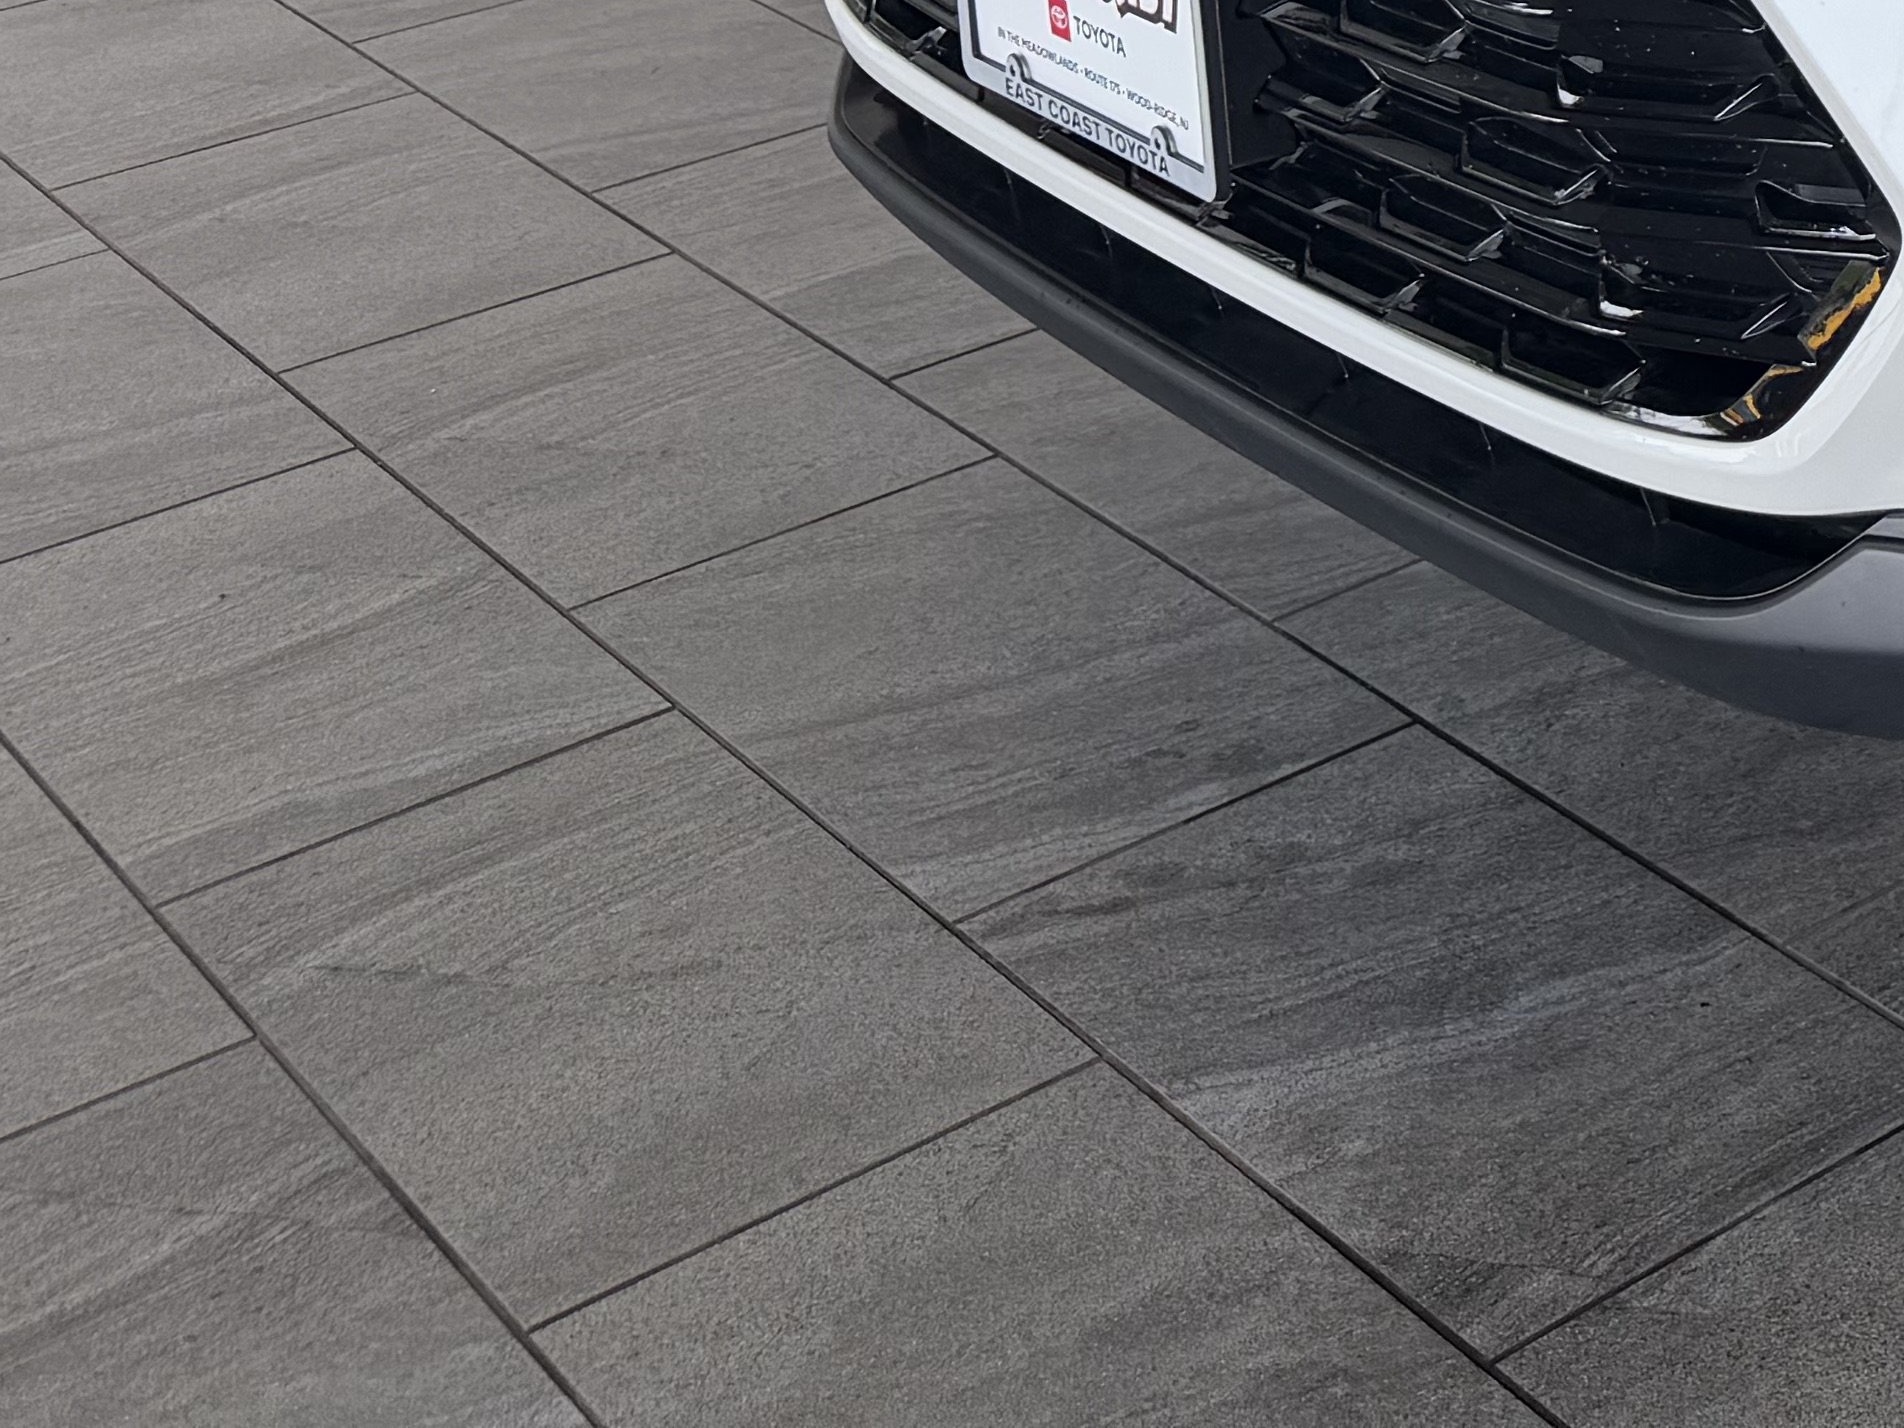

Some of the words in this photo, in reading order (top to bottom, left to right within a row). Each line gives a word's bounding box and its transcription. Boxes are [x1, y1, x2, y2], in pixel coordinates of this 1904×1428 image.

[1073, 15, 1127, 59] TOYOTA
[1005, 77, 1043, 111] EAST
[1048, 99, 1101, 140] COAST
[1104, 127, 1171, 177] TOYOTA
